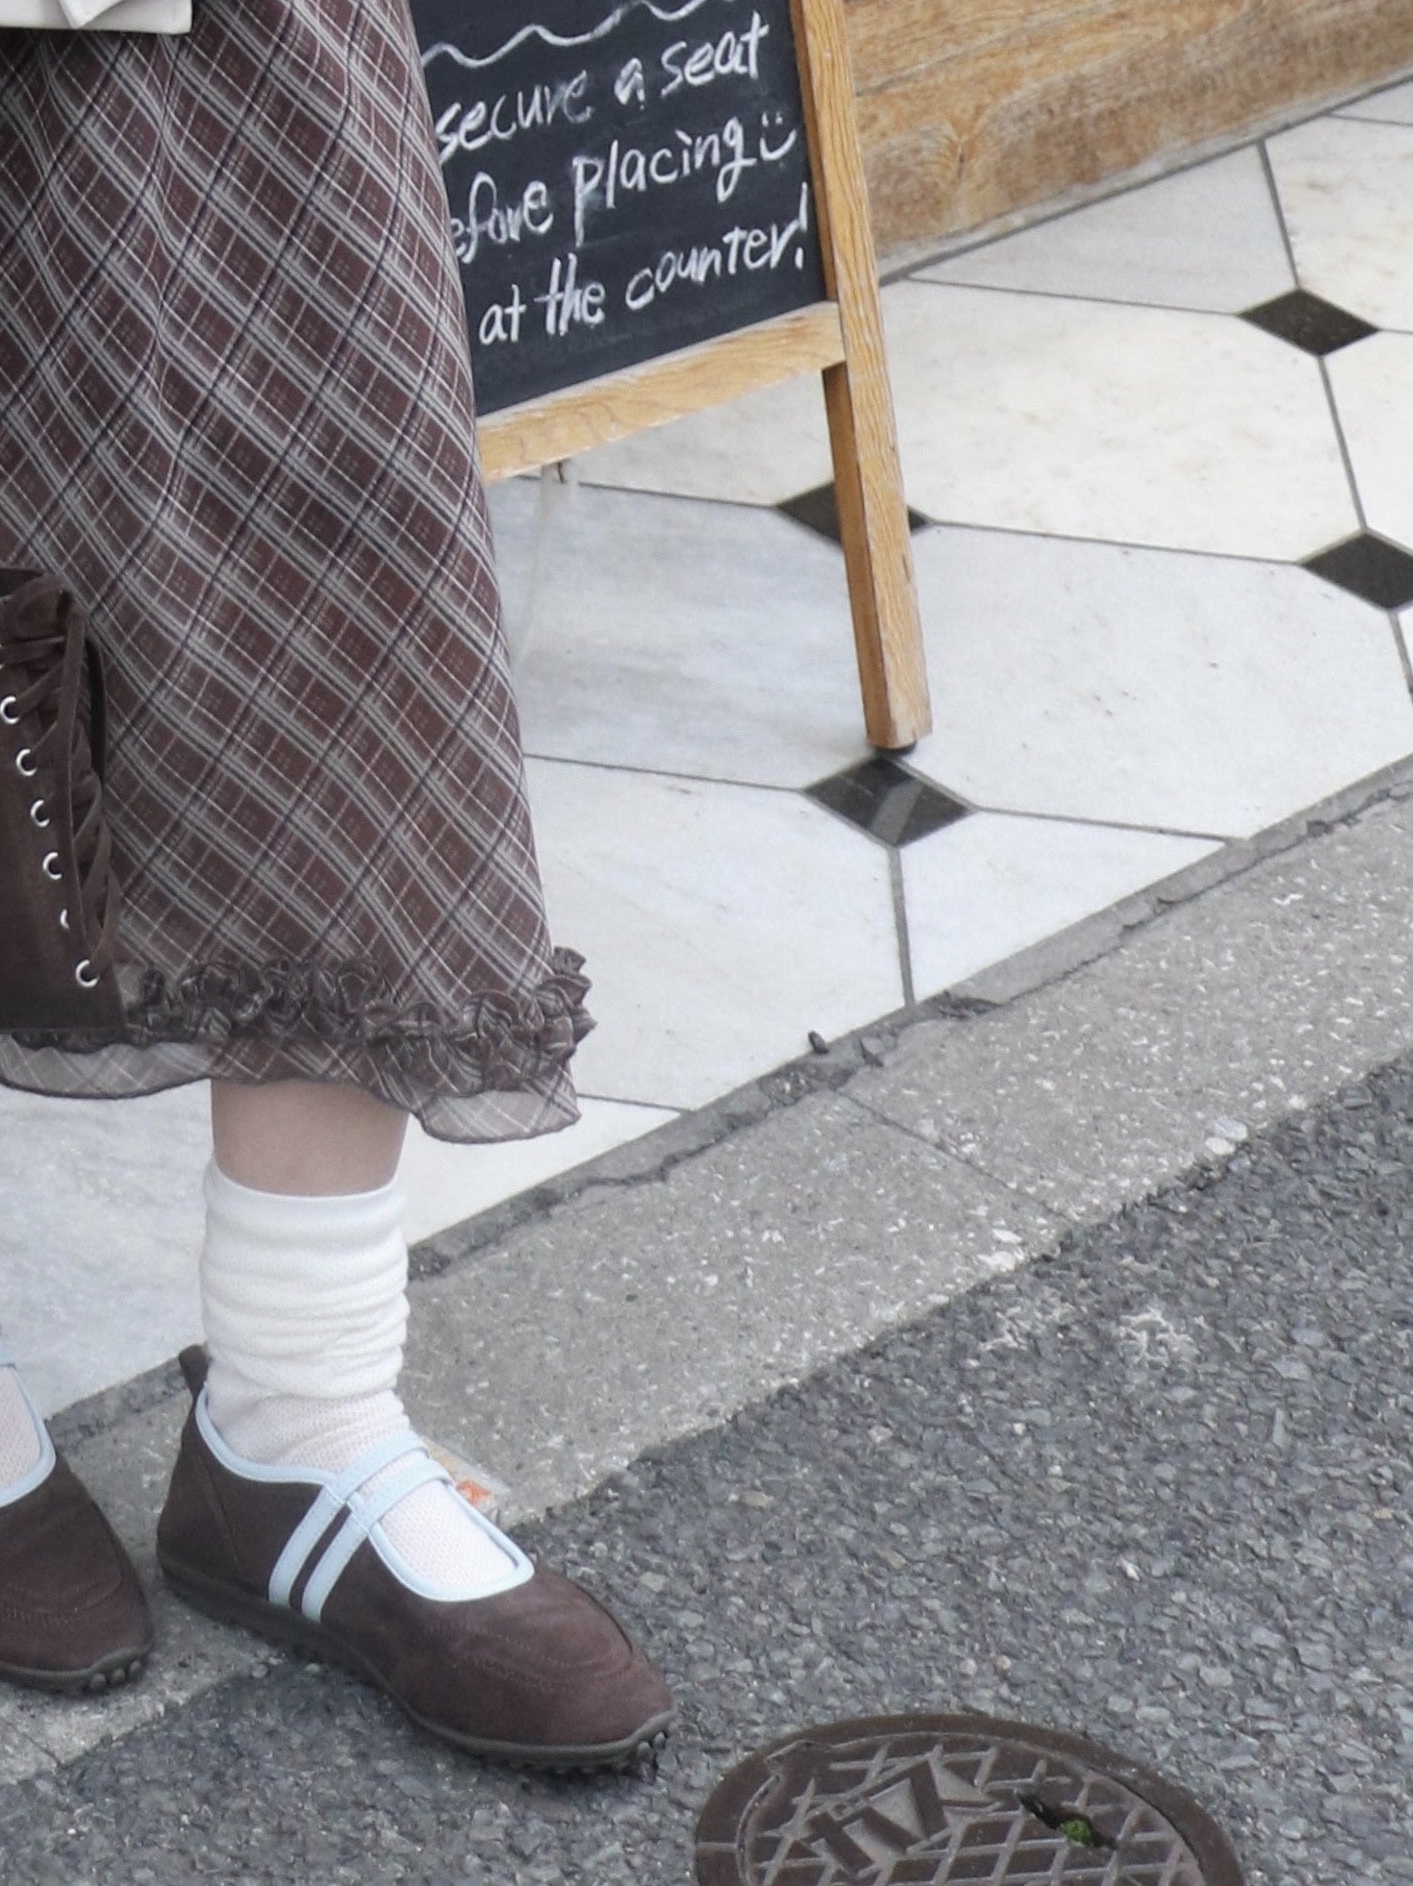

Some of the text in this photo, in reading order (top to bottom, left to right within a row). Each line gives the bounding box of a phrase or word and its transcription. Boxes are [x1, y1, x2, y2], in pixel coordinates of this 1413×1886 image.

[436, 10, 770, 164] secure a seat
[572, 116, 758, 248] placing
[478, 284, 527, 346] at
[534, 251, 606, 337] the
